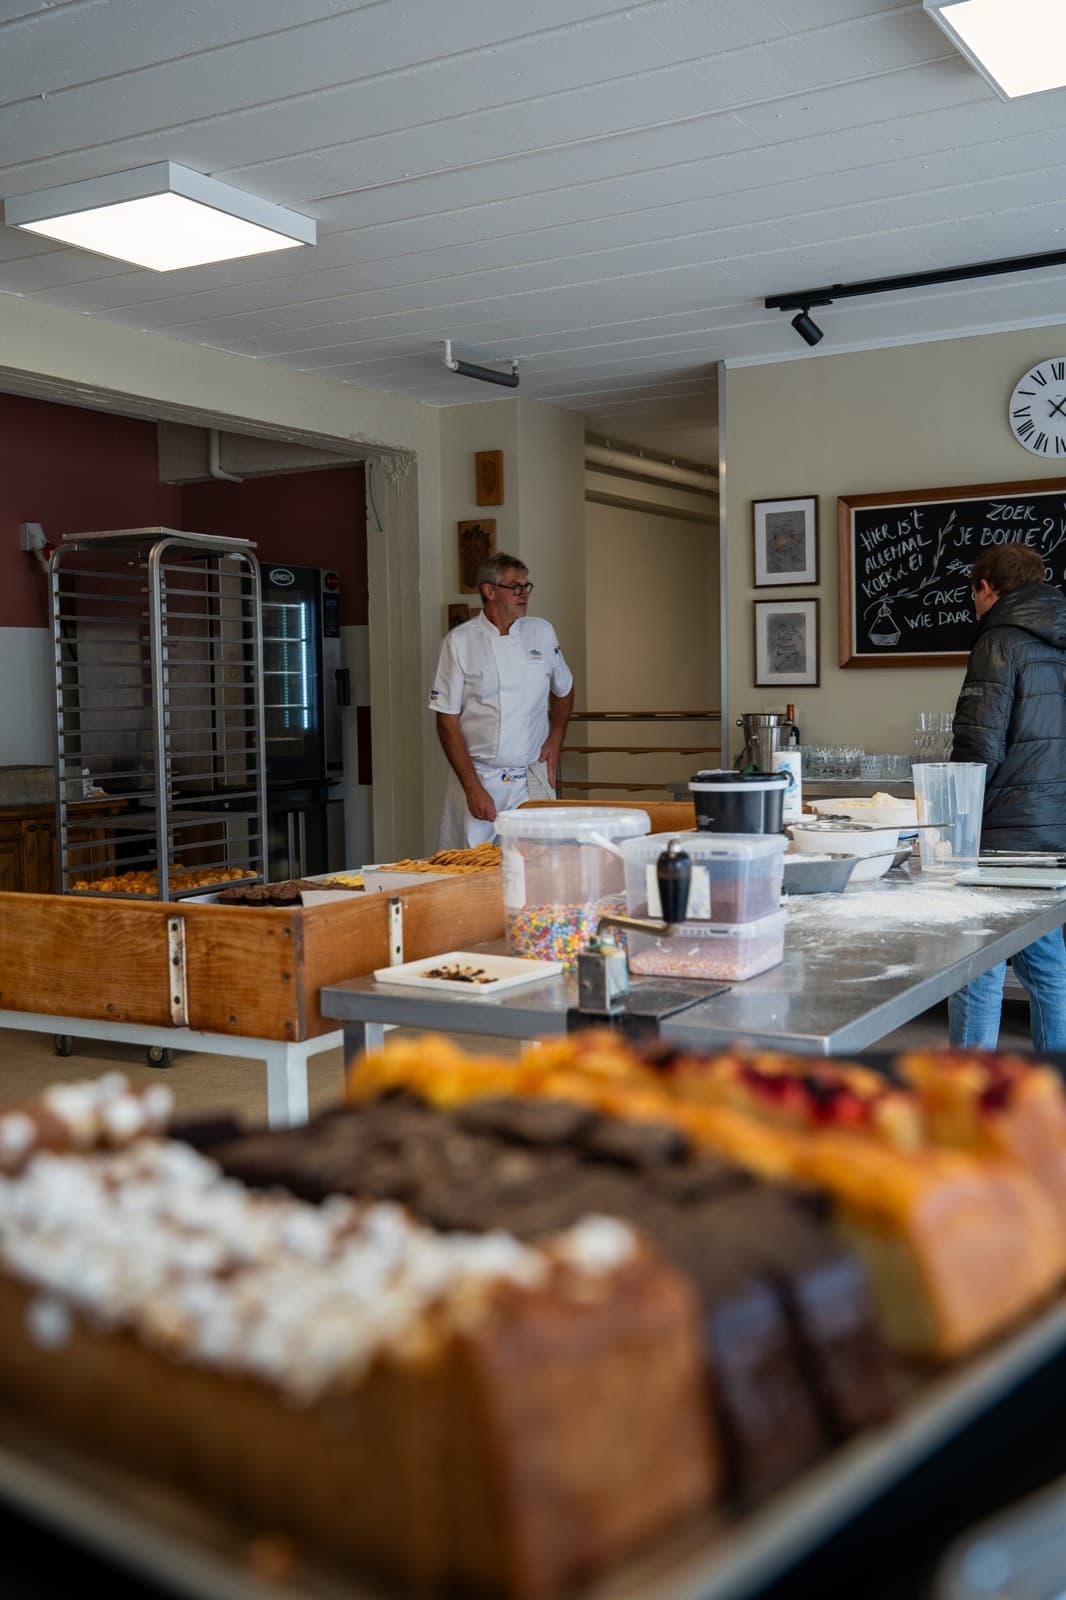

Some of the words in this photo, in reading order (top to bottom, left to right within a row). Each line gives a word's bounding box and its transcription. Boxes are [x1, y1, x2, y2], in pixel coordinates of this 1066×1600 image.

[986, 503, 1038, 520] ZOEK
[860, 523, 897, 552] HIER
[954, 526, 974, 546] JE
[861, 567, 898, 598] KOEK
[909, 553, 922, 571] EI
[923, 585, 968, 606] CAKE
[904, 611, 933, 630] WIE
[938, 609, 974, 626] DAAR
